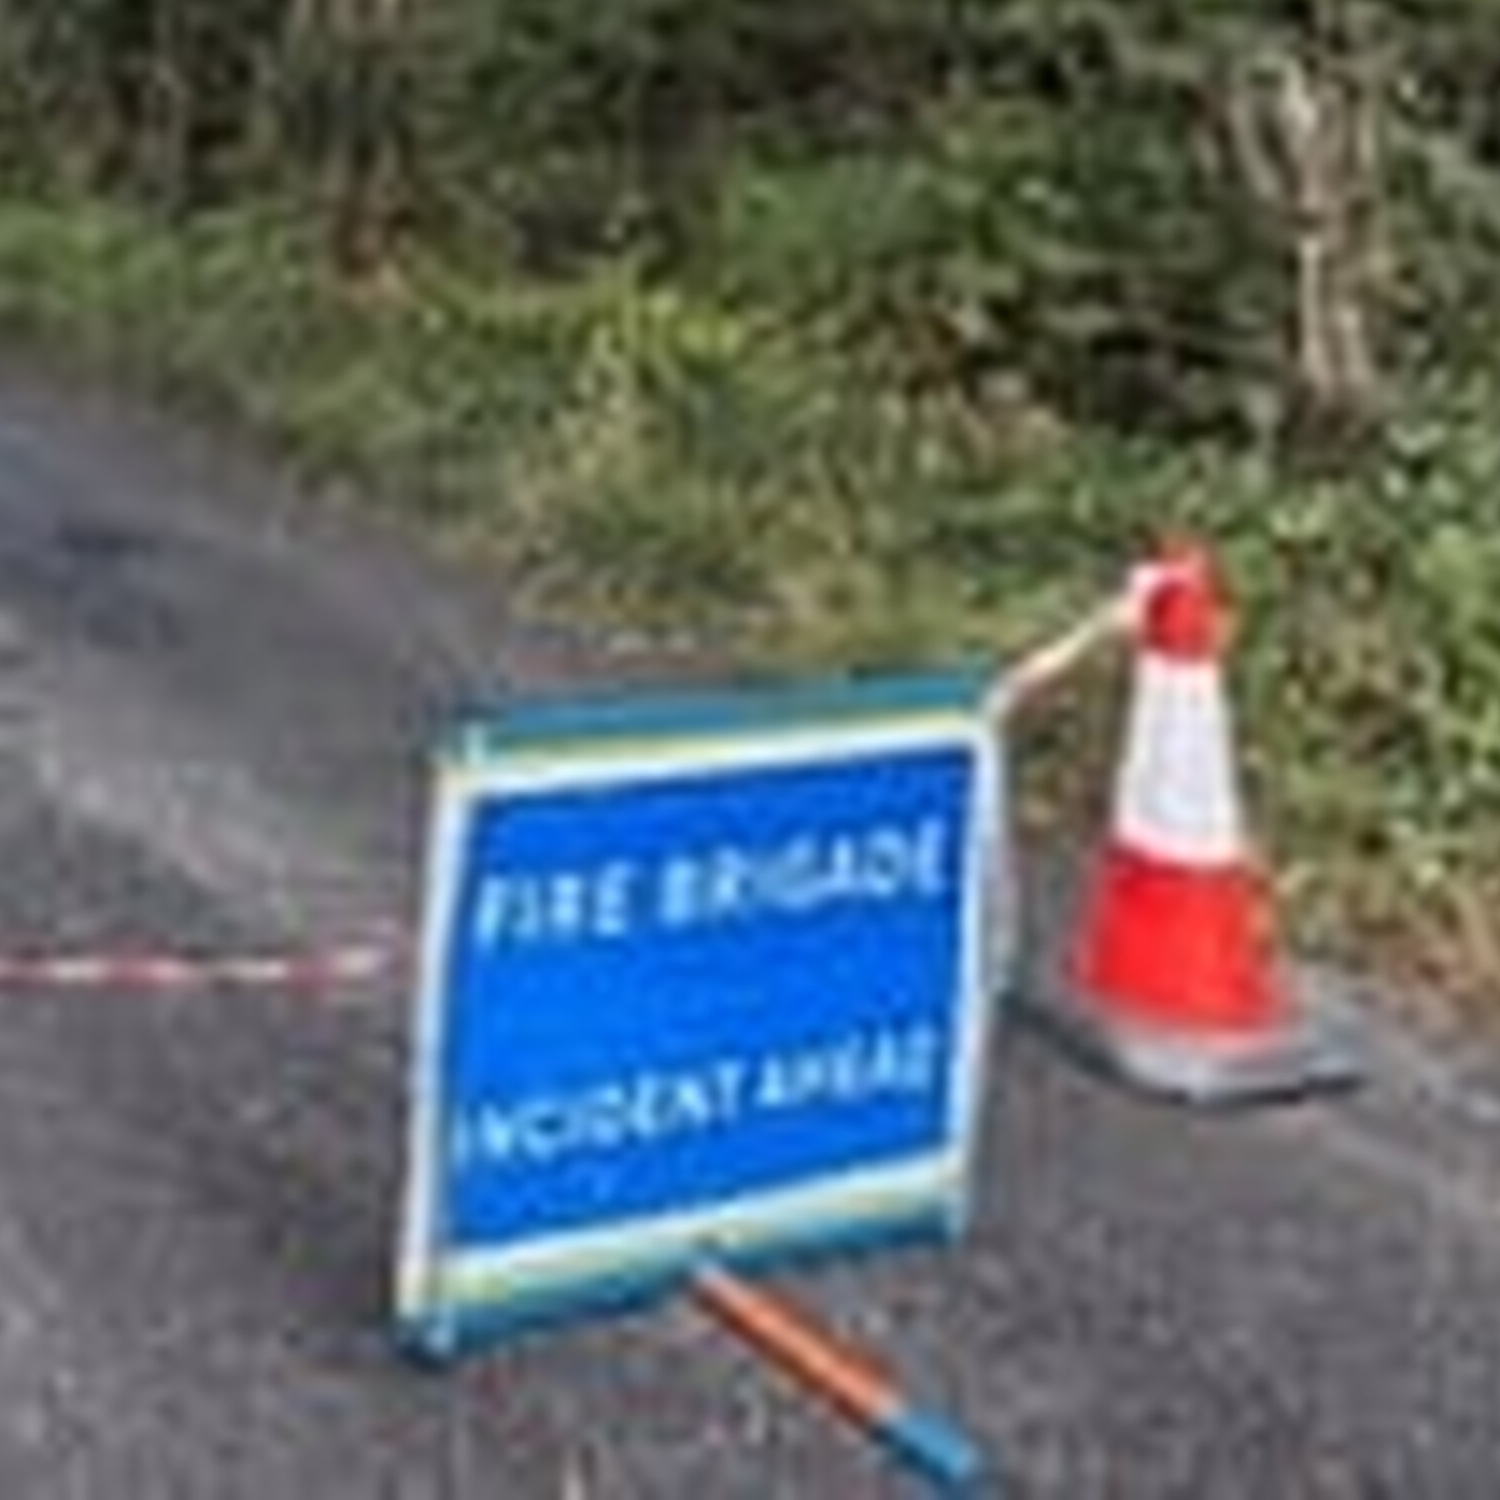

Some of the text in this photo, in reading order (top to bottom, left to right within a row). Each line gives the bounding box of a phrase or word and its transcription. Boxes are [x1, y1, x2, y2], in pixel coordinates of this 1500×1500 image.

[476, 815, 949, 947] FIRE BRIGADE
[455, 1020, 941, 1167] INCIDENT AHEAD
